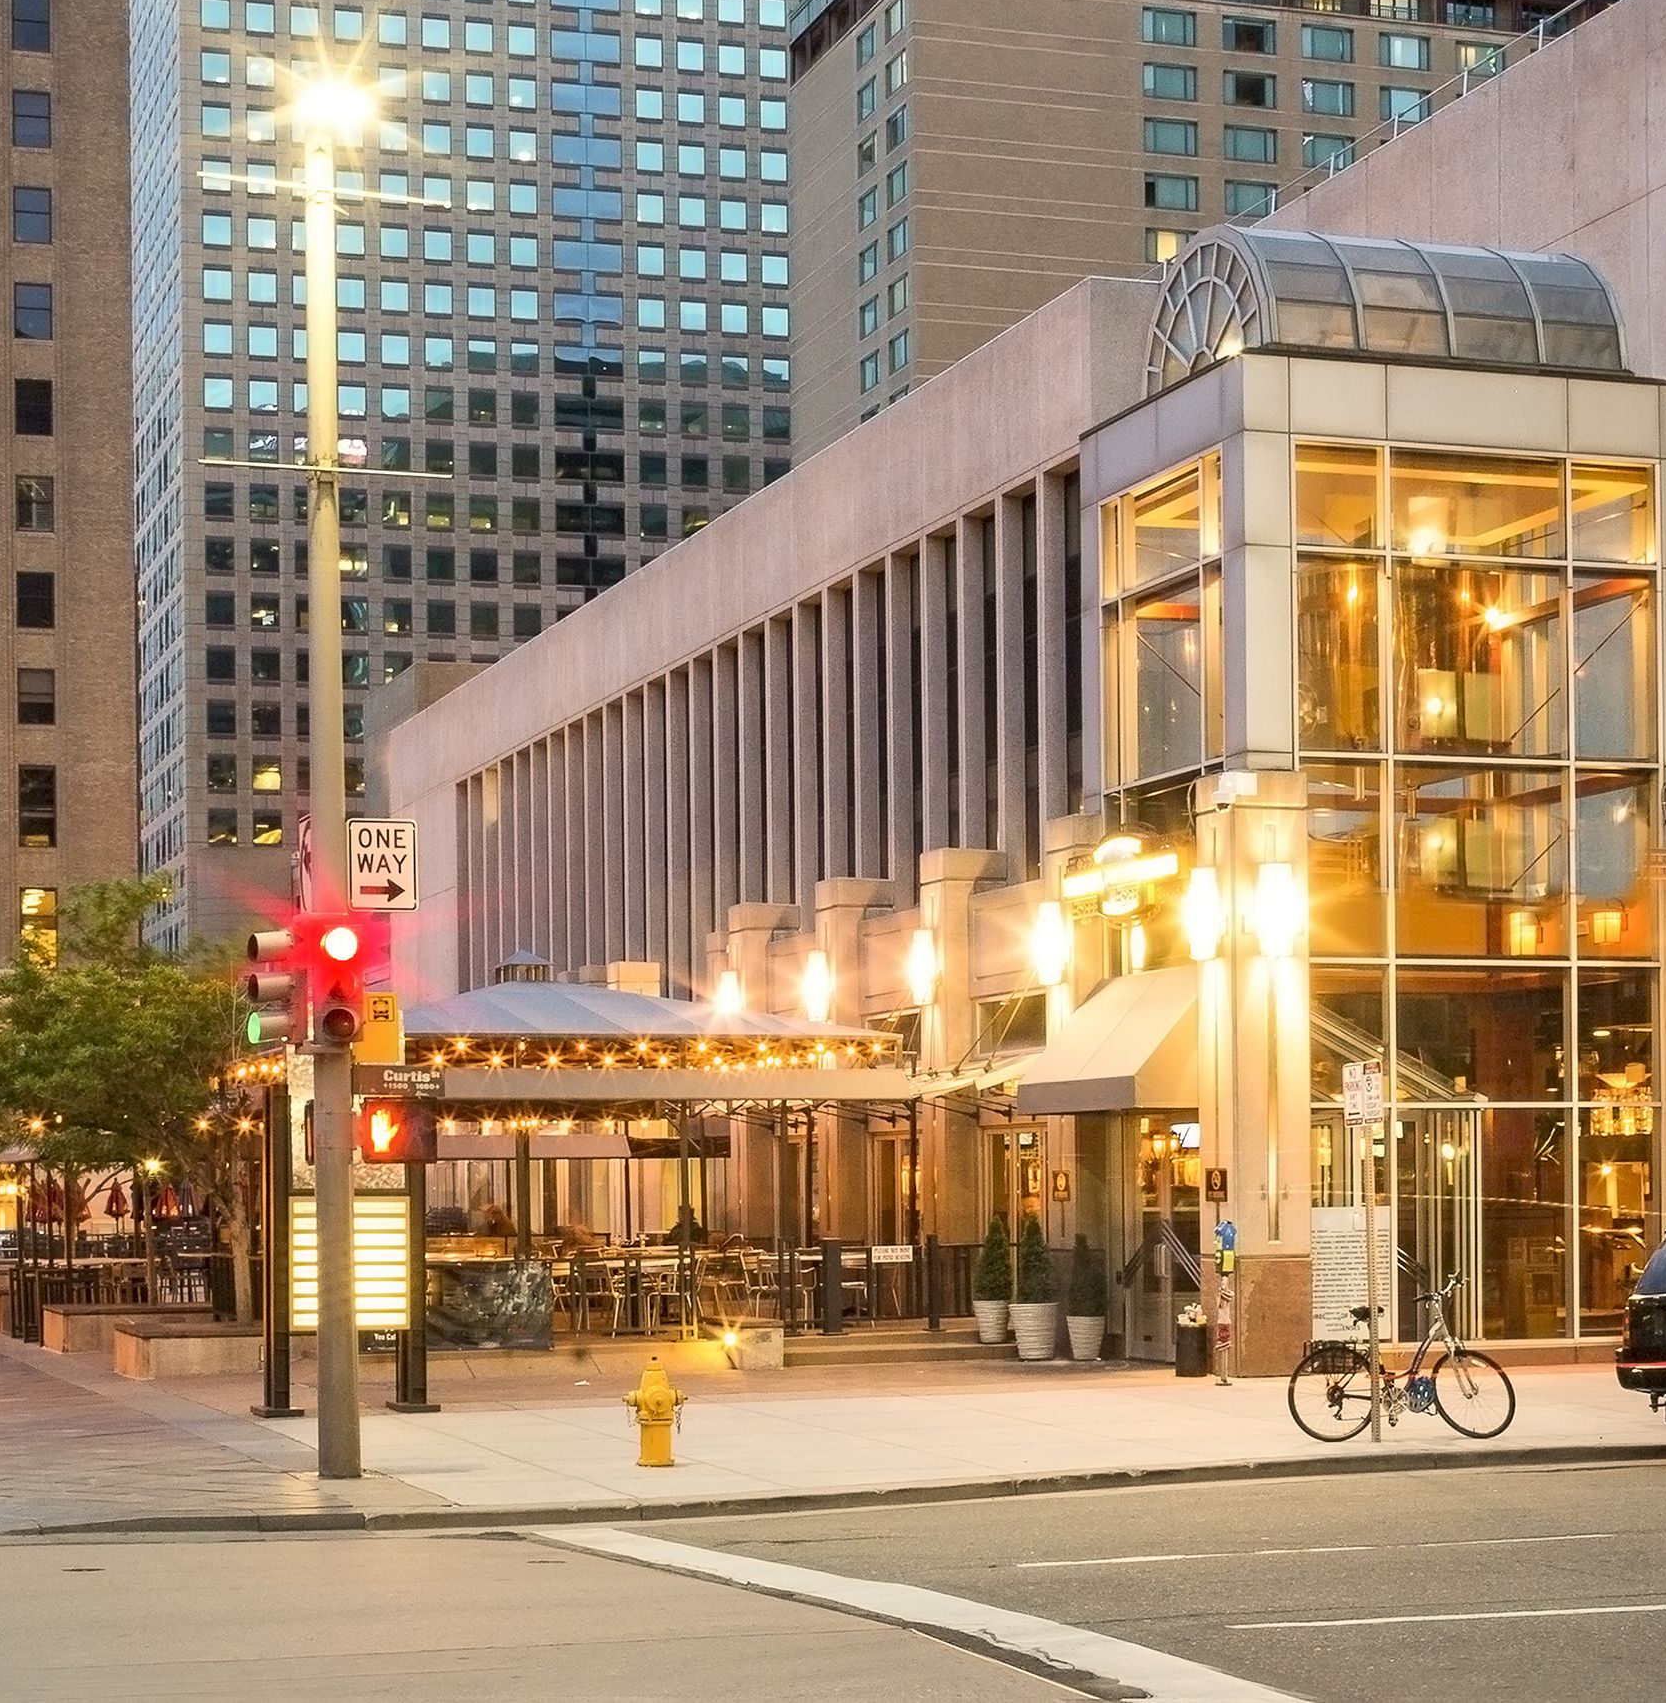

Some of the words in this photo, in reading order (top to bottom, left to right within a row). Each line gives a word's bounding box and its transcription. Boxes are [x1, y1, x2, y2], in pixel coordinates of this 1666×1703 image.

[358, 828, 406, 849] ONE
[357, 853, 407, 874] WAY
[383, 1069, 431, 1082] Curtis
